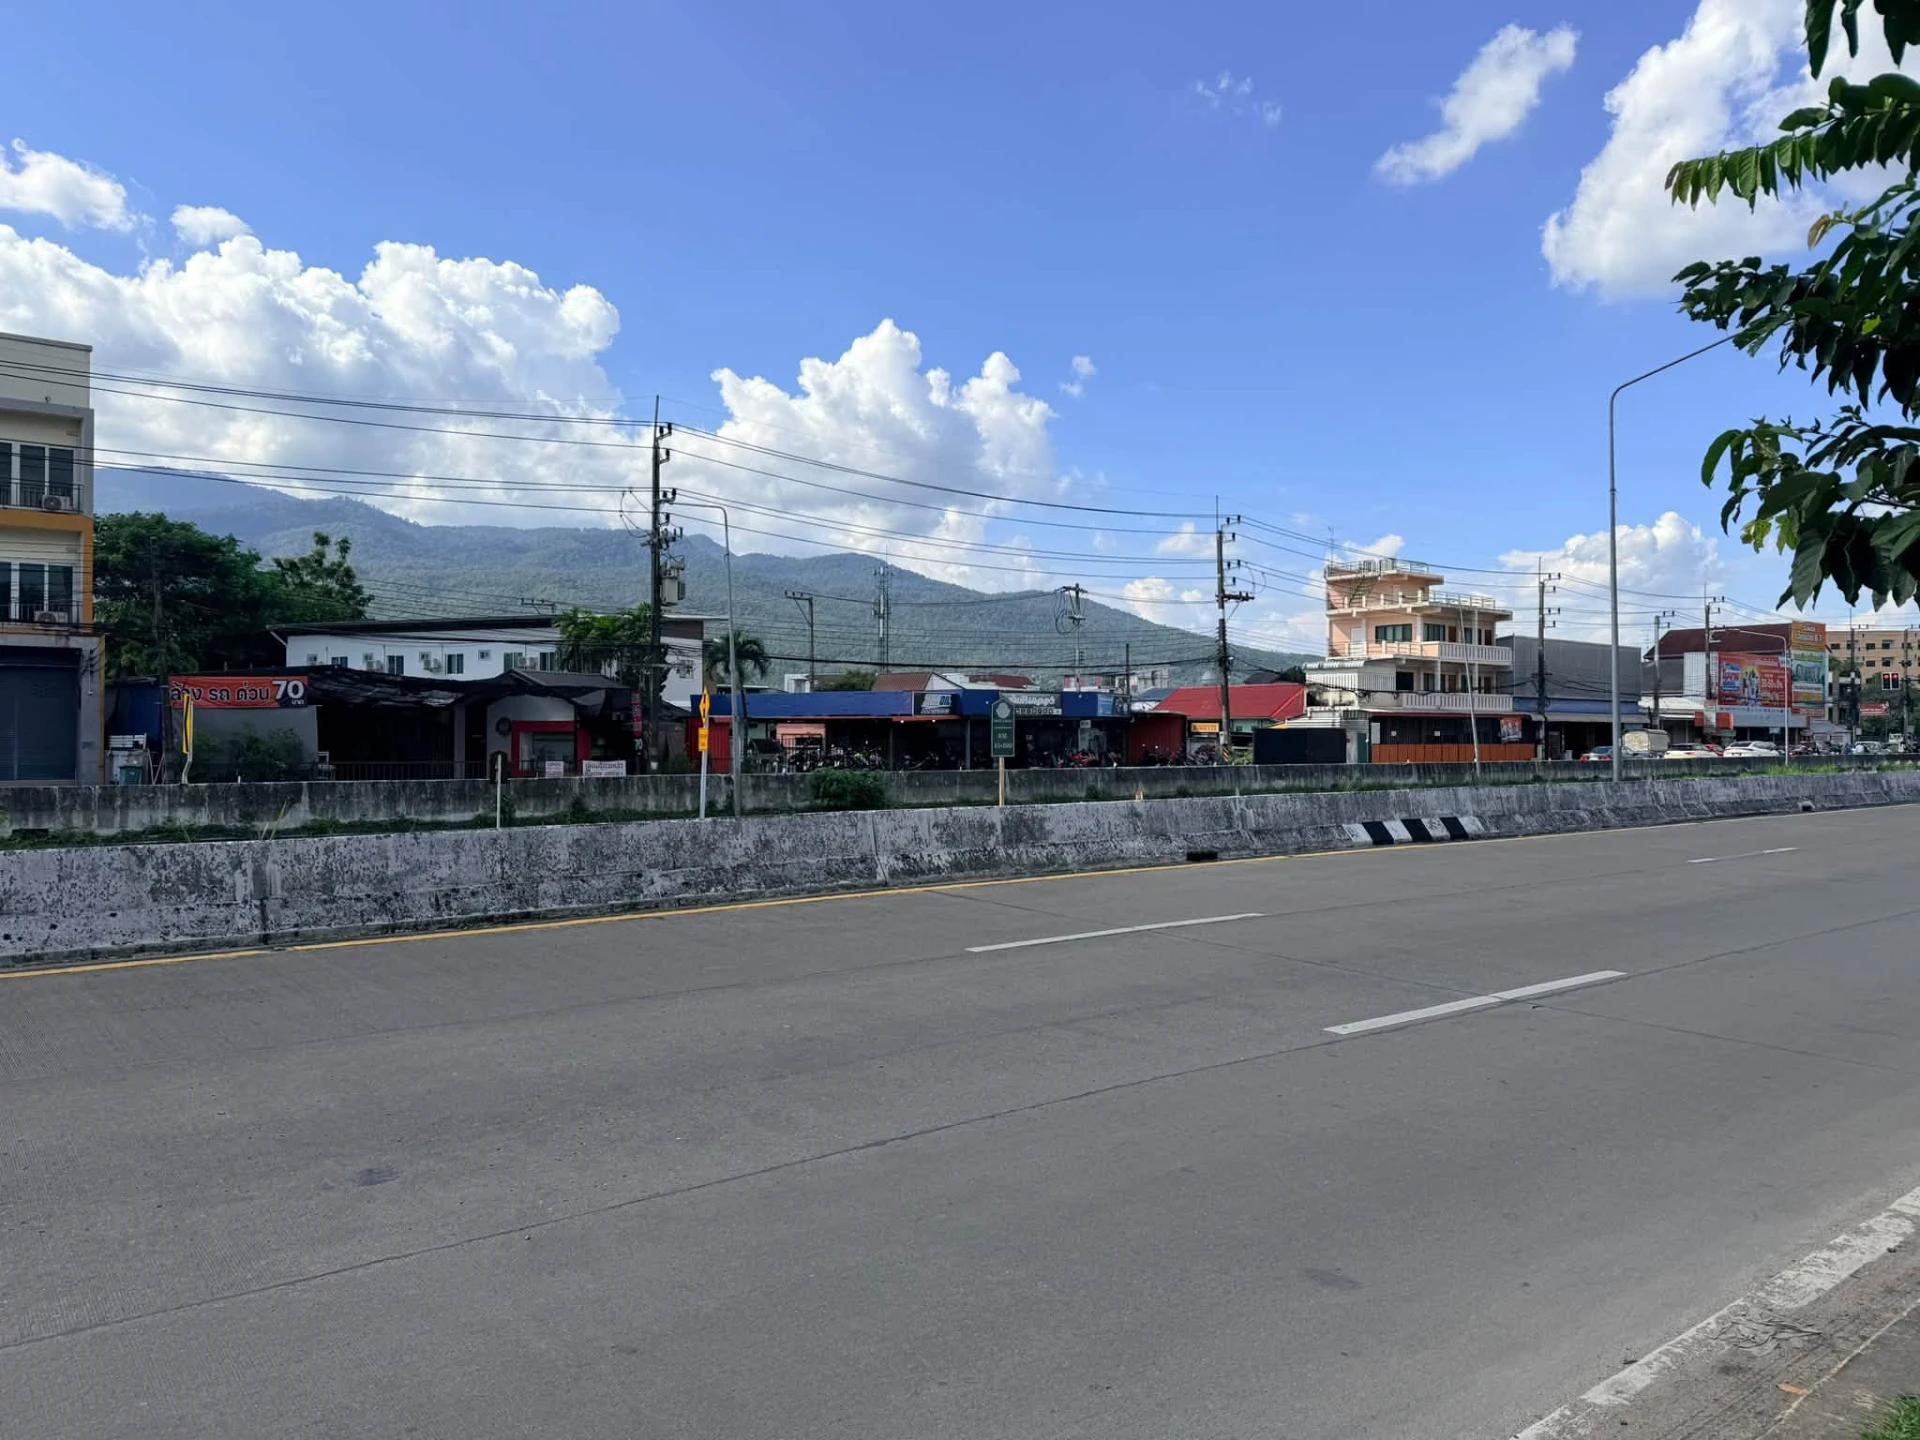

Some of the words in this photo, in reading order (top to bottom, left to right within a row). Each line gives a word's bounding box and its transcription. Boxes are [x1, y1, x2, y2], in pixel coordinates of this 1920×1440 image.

[171, 682, 202, 702] ล้าง
[209, 687, 230, 702] รถ
[236, 682, 270, 702] ด่วน
[272, 680, 305, 699] 70
